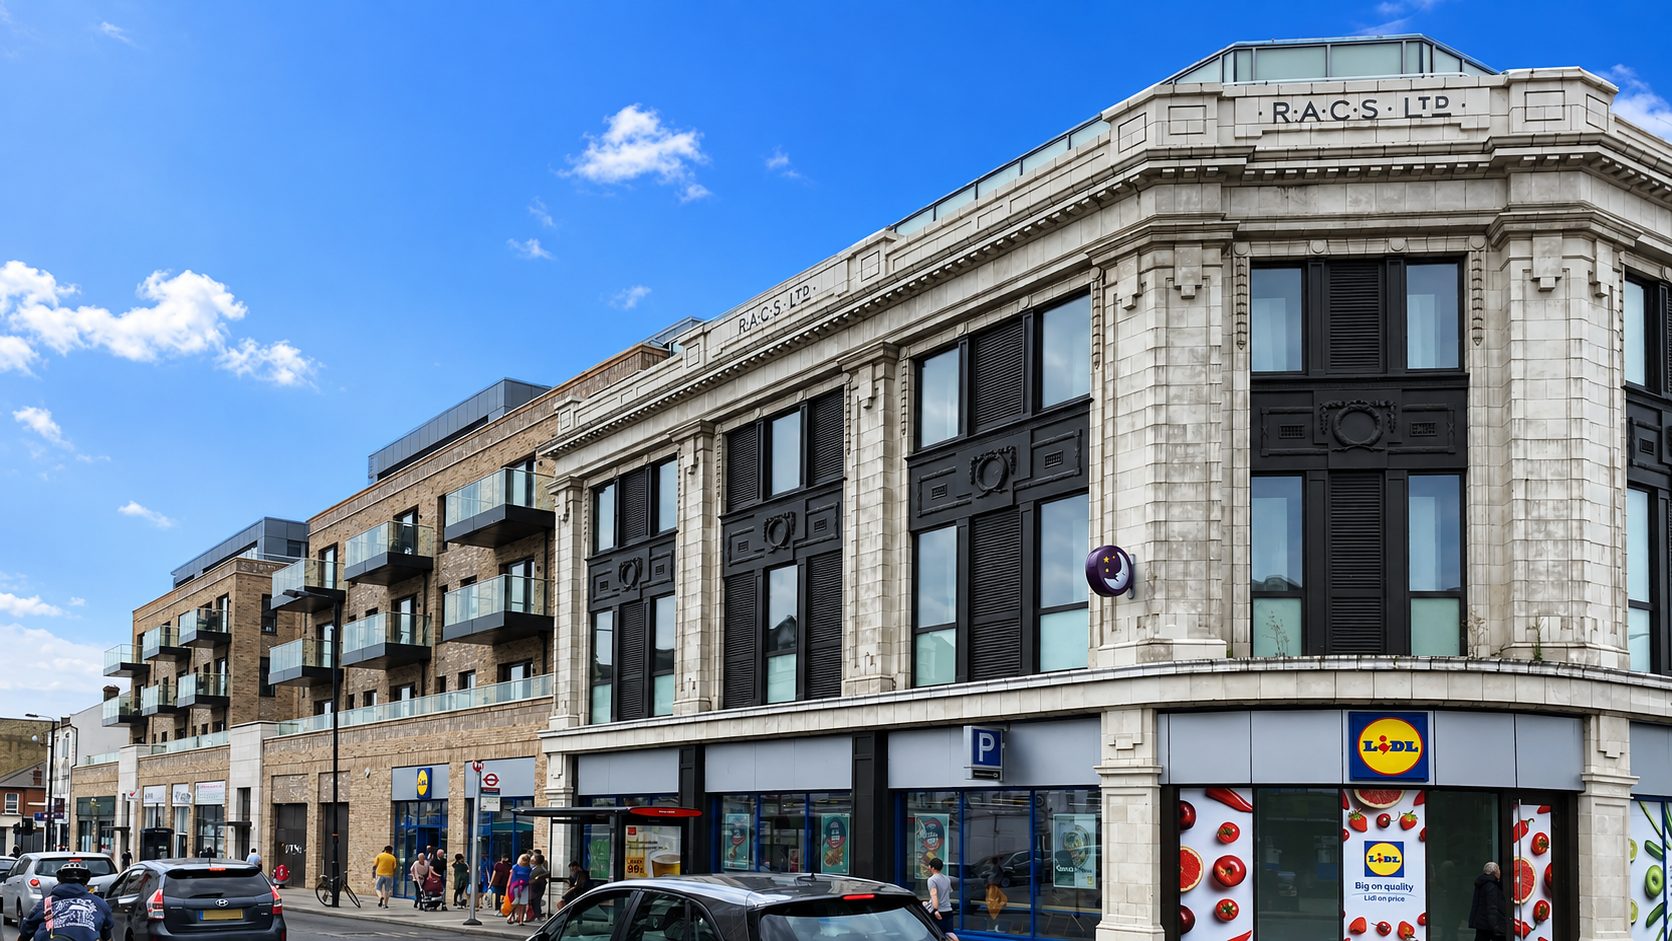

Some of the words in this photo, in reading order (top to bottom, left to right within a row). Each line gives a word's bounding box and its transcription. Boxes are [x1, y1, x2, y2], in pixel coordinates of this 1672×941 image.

[979, 732, 995, 762] P
[1355, 882, 1370, 892] Big
[1384, 882, 1414, 892] quality
